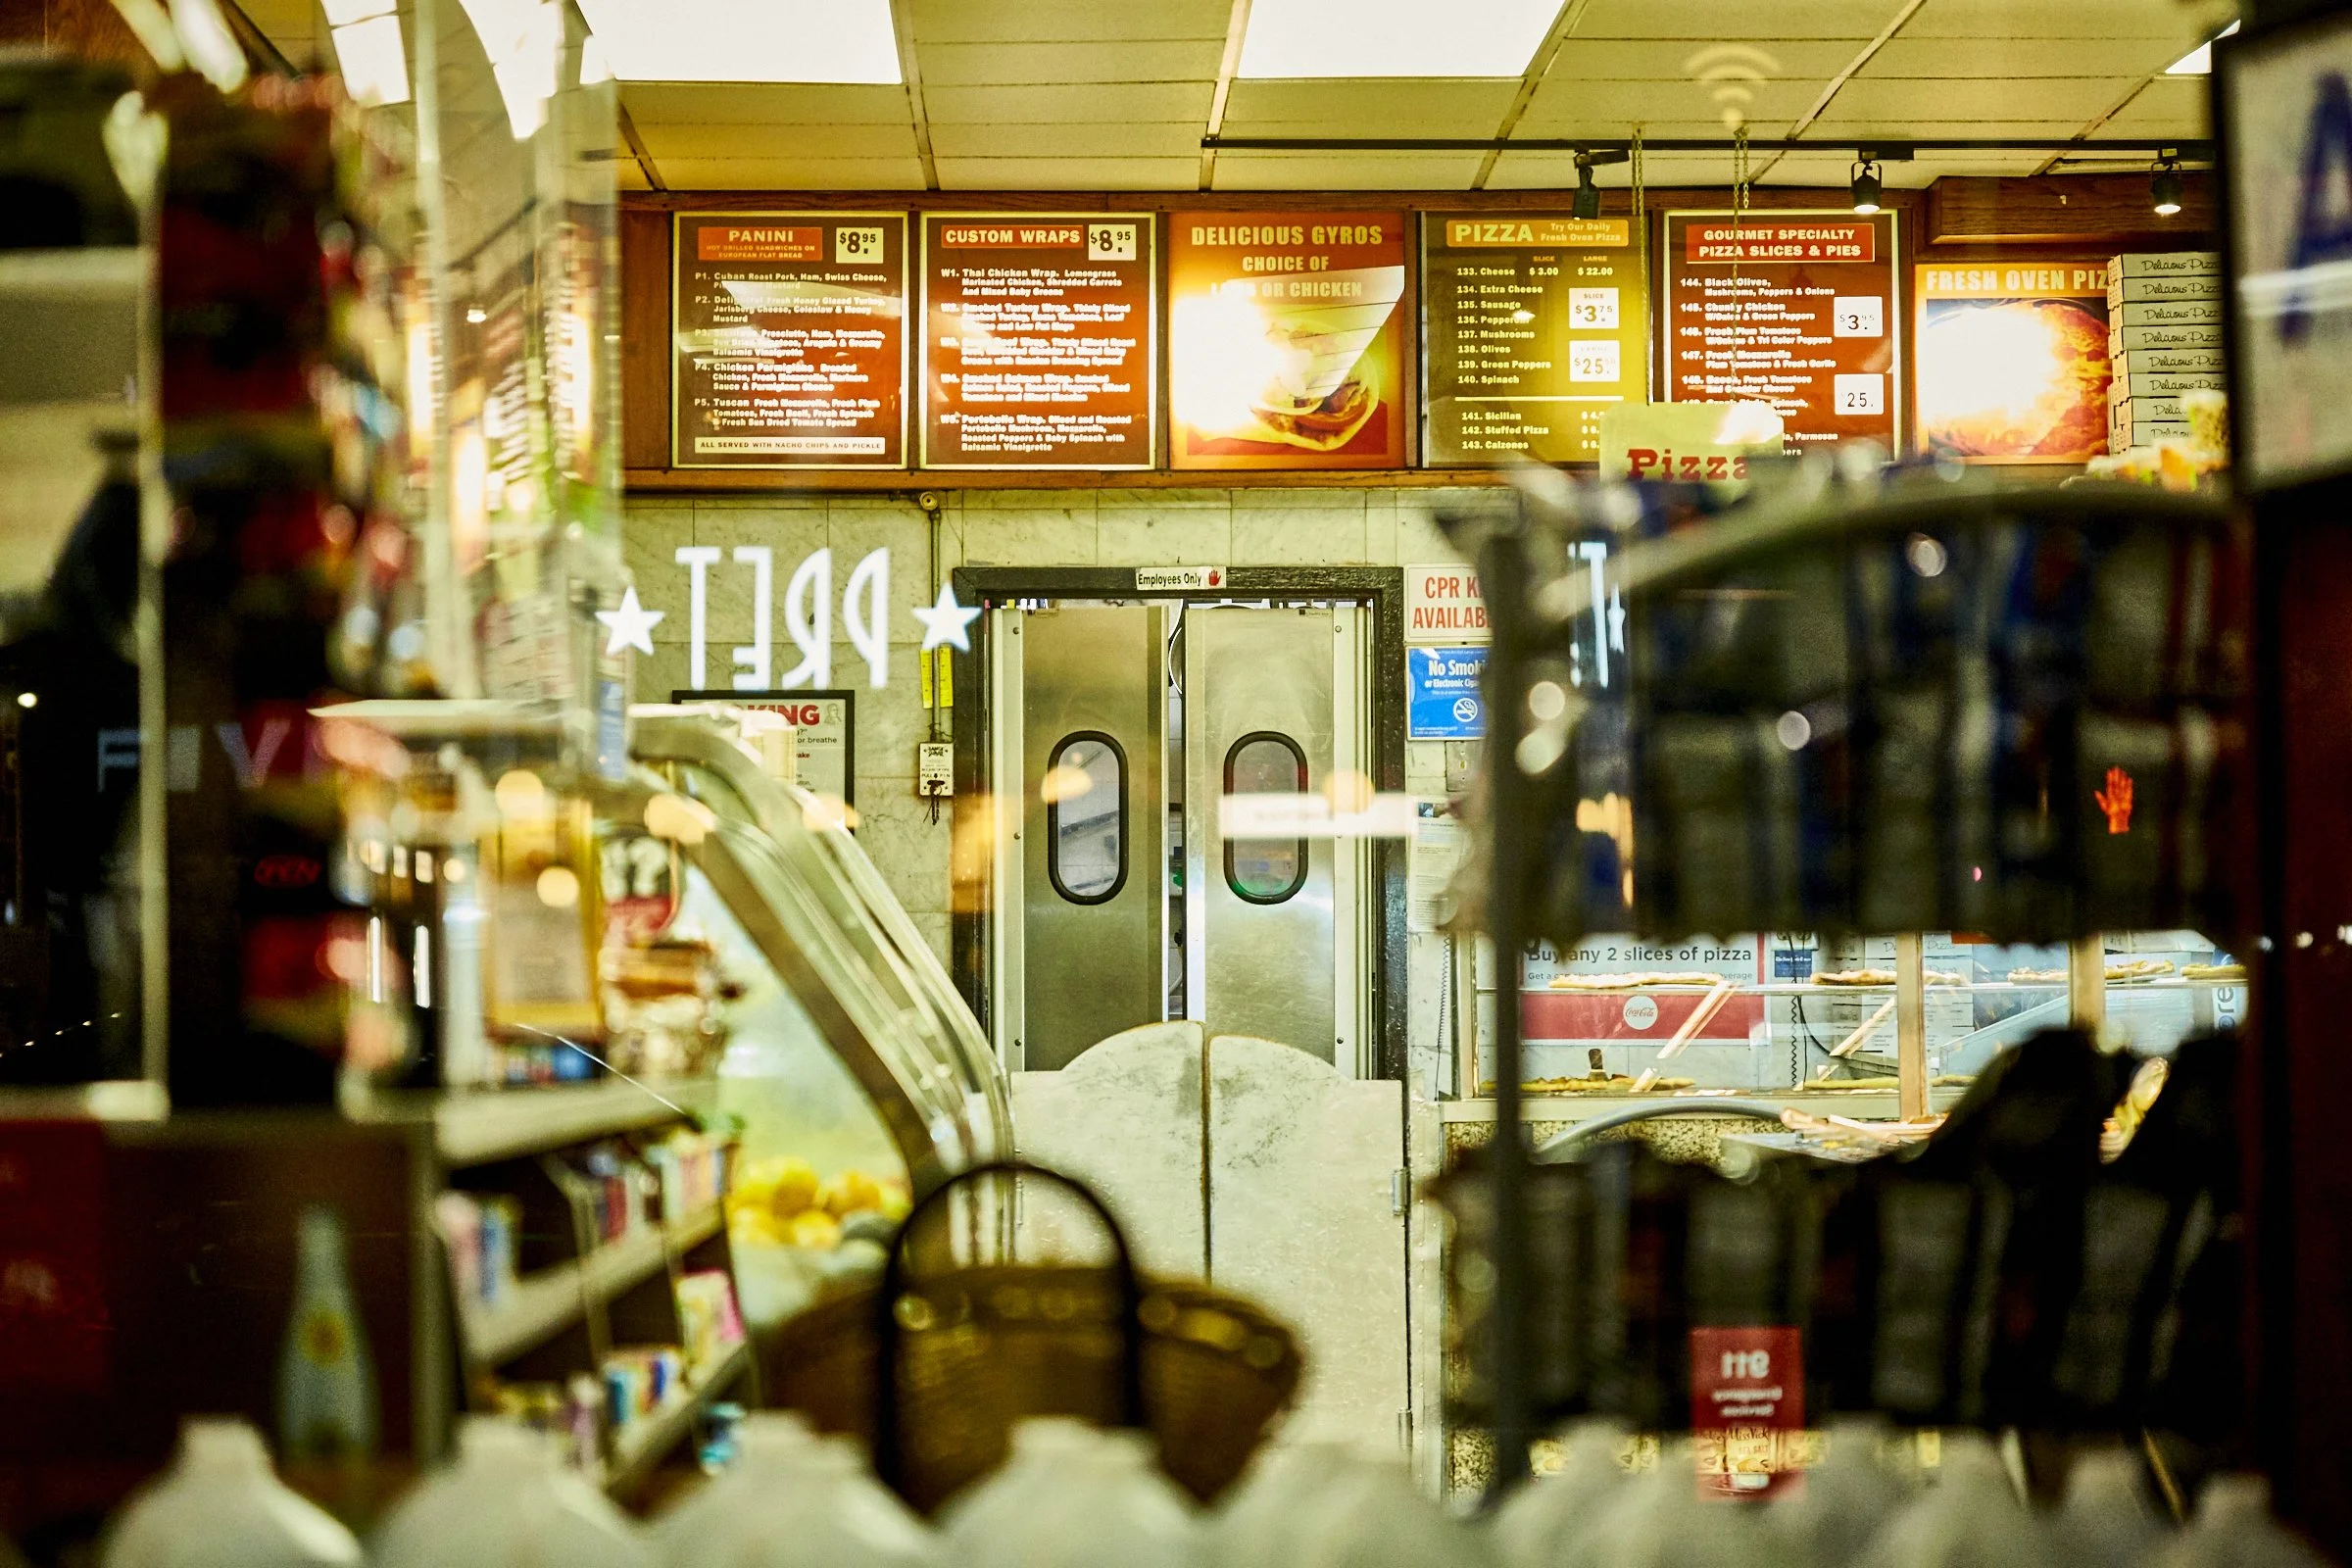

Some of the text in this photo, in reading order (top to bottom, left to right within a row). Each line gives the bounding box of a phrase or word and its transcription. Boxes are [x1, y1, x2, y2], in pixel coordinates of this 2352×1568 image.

[1455, 223, 1534, 242] PIZZA
[1551, 222, 1565, 232] Try
[1588, 222, 1610, 232] Daily
[729, 230, 793, 242] PANINI
[946, 230, 1080, 243] CUSTOM WRAPS
[1192, 225, 1383, 245] DELICIOUS GYROS
[1541, 233, 1621, 242] Fresh Oven Pizza
[1704, 229, 1854, 240] GOURMET SPECIALTY
[1699, 245, 1861, 257] PIZZA SLICES & PIES
[1243, 256, 1329, 271] CHOICE OF
[2142, 259, 2219, 270] Delicious Pizz
[1065, 270, 1116, 279] Lemongrass
[1927, 270, 2107, 291] FRESH OVEN PIZ
[1262, 282, 1284, 297] OR
[1290, 281, 1361, 297] CHICKEN
[2142, 283, 2220, 294] Delicious Pizz
[1480, 301, 1521, 310] Sausage
[2144, 308, 2219, 319] Delicious Pizz
[2142, 331, 2221, 343] Delicious Pizz
[1458, 345, 1510, 354] 138. Olives
[1512, 361, 1551, 369] Peppers
[2149, 355, 2225, 367] Delicious Pizz
[1482, 375, 1519, 384] Spinach
[2150, 379, 2226, 390] Delicious Pizz
[1462, 412, 1521, 420] 141. Sicilian
[1627, 449, 1748, 480] Pizza
[1139, 573, 1200, 587] Employees Only
[1425, 577, 1459, 598] CPR
[1413, 608, 1492, 629] AVAILAB
[1429, 661, 1446, 676] No
[1528, 947, 1751, 964] Buy any 2 slices of pizza
